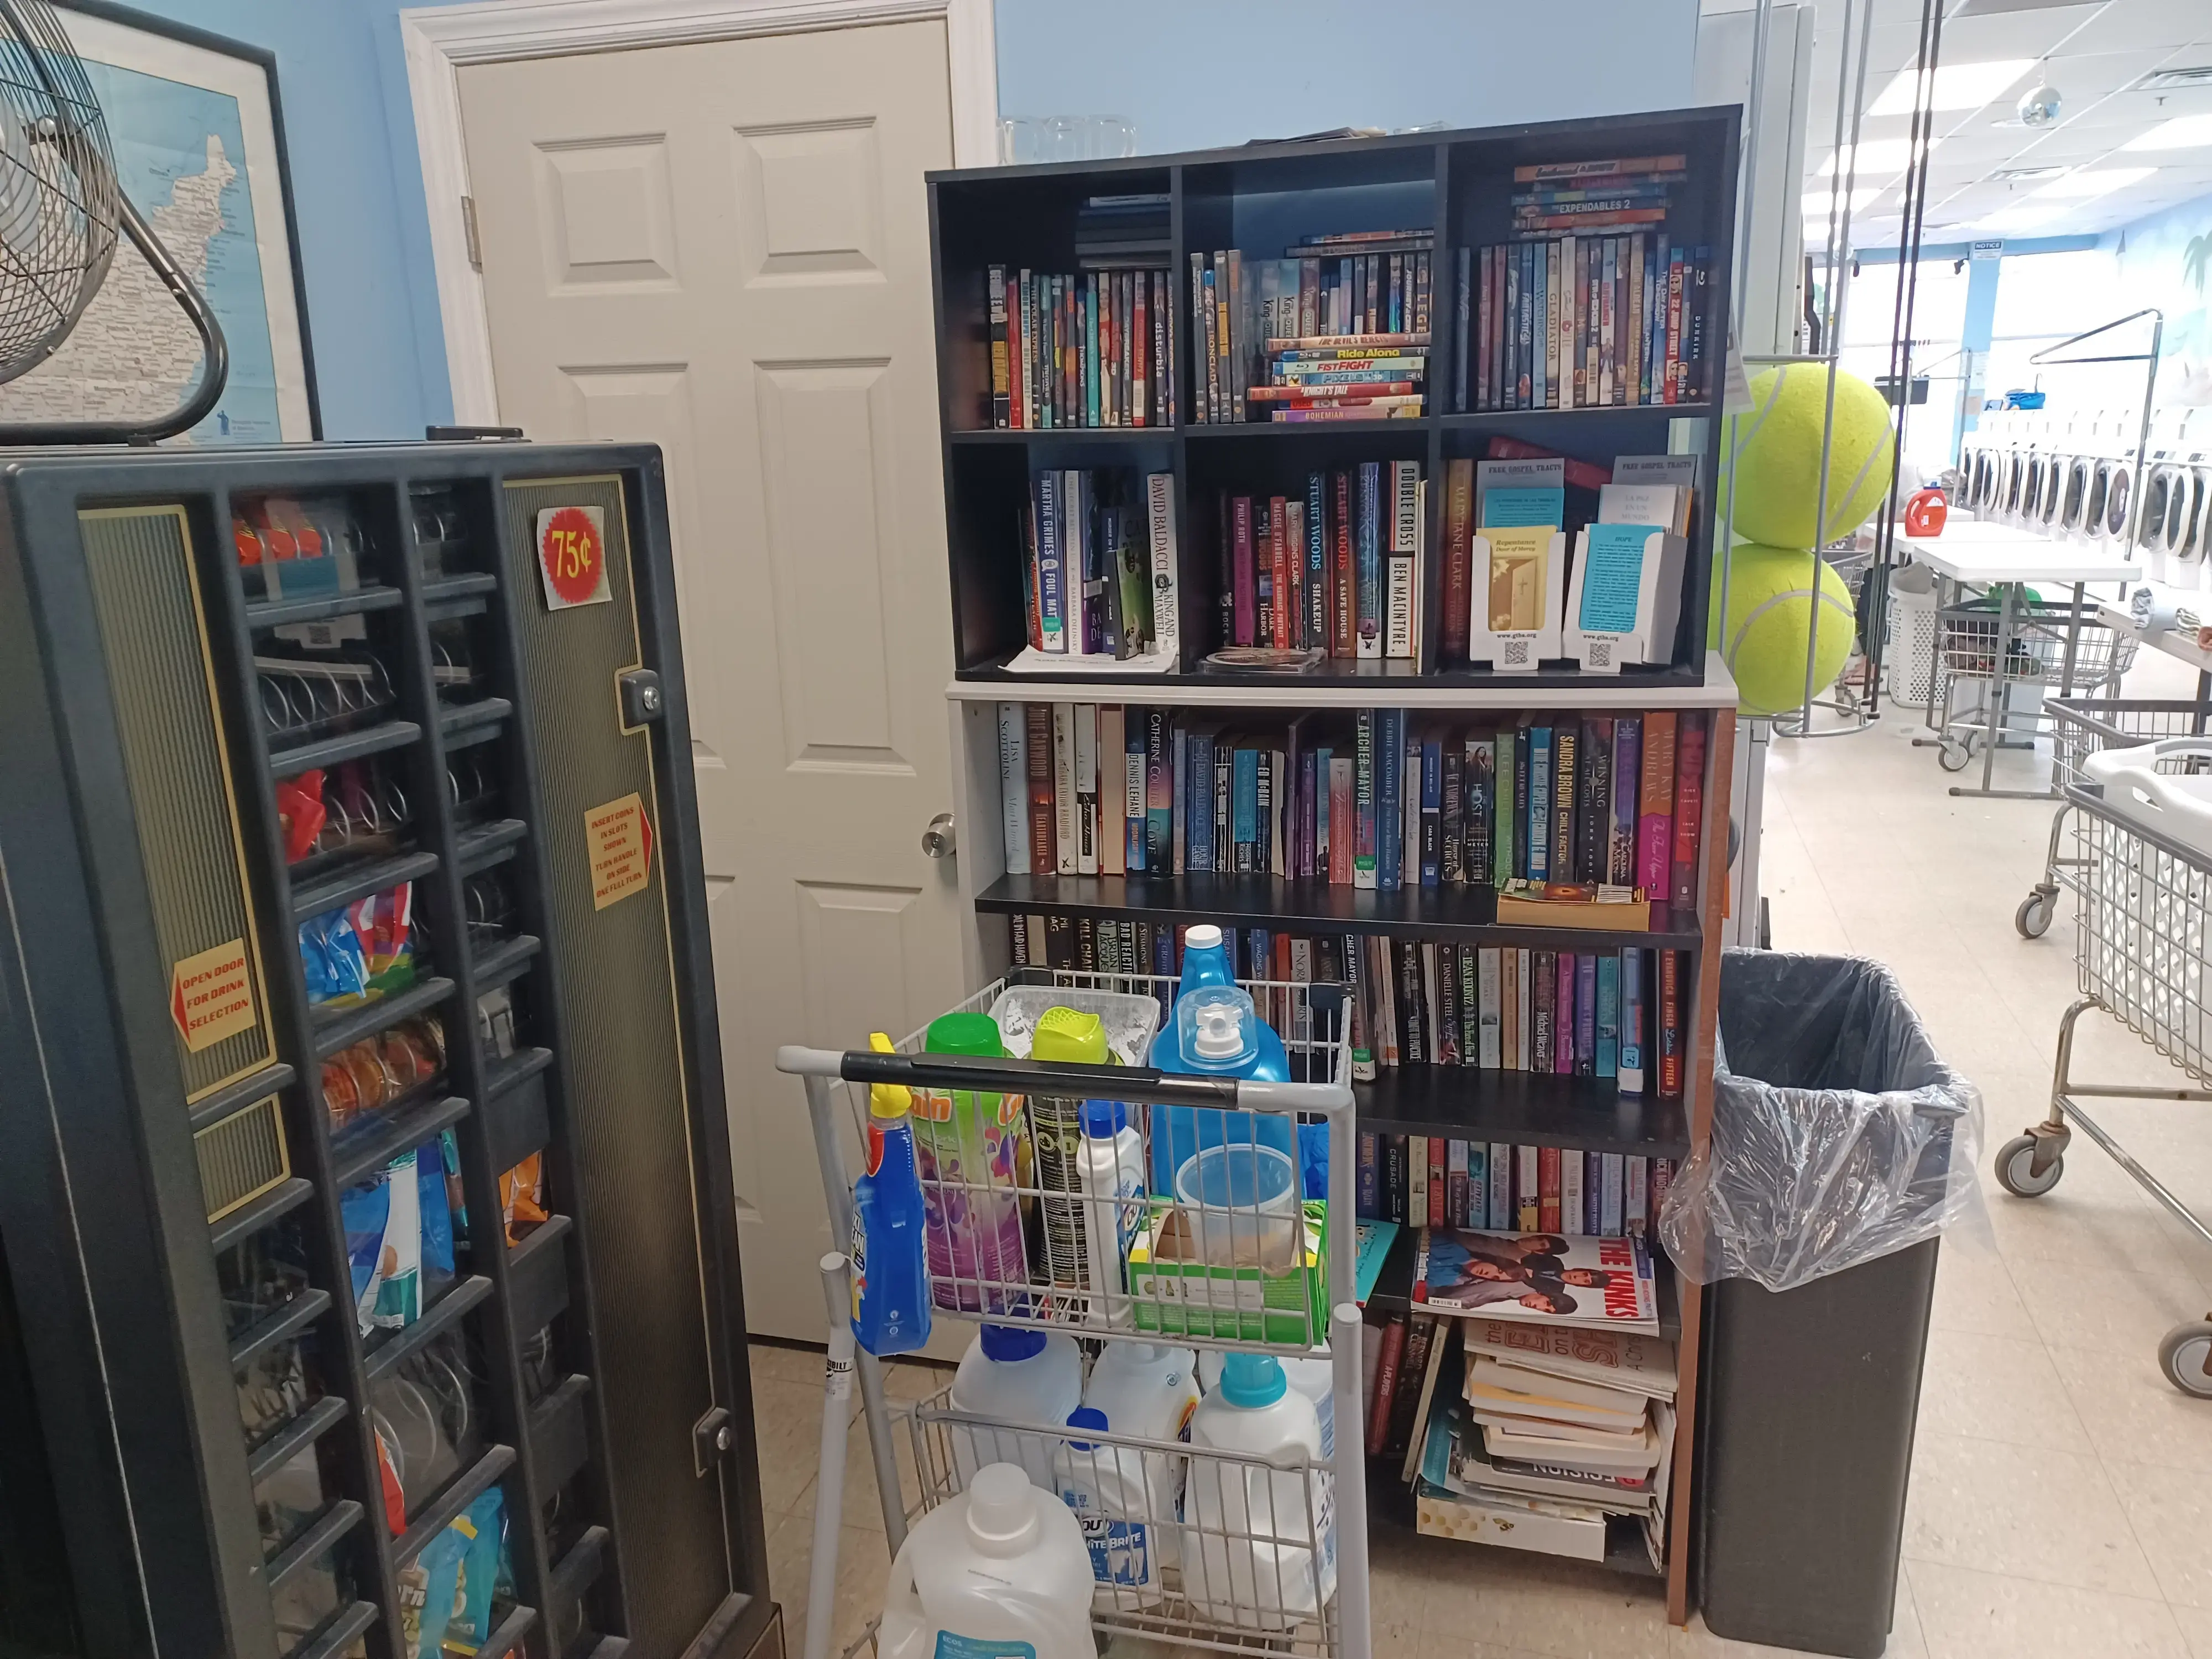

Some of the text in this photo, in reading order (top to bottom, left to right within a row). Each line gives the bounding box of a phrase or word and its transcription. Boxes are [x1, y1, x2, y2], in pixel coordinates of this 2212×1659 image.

[1559, 200, 1630, 213] EXPENDABLES 2
[1333, 337, 1358, 345] DEVIL'S
[1548, 293, 1557, 361] GLADIATOR
[1669, 299, 1679, 356] 22 JUMP STREET
[1111, 362, 1117, 375] 3D
[1208, 330, 1218, 382] IRONCLAD
[1337, 349, 1400, 358] Ride Along
[1338, 361, 1374, 370] FIGHT
[1274, 503, 1282, 529] MAGGIE
[1337, 476, 1348, 522] STUART
[1400, 468, 1415, 545] DOUBLE CROSS
[1152, 478, 1168, 570] DAVID BALDACCI
[1452, 486, 1464, 589] MARY JANE CLARK
[551, 530, 592, 579] 75¢
[1274, 532, 1282, 567] O'FARRELL
[1310, 477, 1321, 633] STUART WOODS SHAKEUP
[1338, 524, 1348, 570] WOODS
[1154, 594, 1164, 637] MAXWELL
[1164, 594, 1175, 637] KING AND
[1392, 564, 1407, 645] BEN MACINTYRE
[1000, 720, 1010, 780] SCOTTOLINE
[1010, 740, 1019, 762] LISA
[1358, 725, 1370, 805] ARCHER MAYOR
[1502, 754, 1510, 776] LEE
[1645, 732, 1658, 802] ANDREWS
[1660, 729, 1674, 802] MARY KAY
[1028, 707, 1048, 855] JULIE GARWOOD HEARTBREAKER
[1129, 755, 1139, 784] DENNIS
[1147, 714, 1161, 854] CATHERINE COULTER COVE
[1258, 767, 1269, 806] ED McBAIN
[1597, 755, 1607, 807] WINNING
[1129, 786, 1139, 817] LEHANE
[1472, 784, 1482, 817] HOST
[1557, 735, 1574, 864] SANDRA BROWN CHILL FACTOR
[592, 807, 634, 828] INSERT COINS
[601, 823, 628, 839] IN SLOTS
[596, 848, 637, 872] TURN HANDLE
[604, 837, 627, 851] SHOWN
[1649, 818, 1665, 879] The Fixer Upper
[597, 872, 642, 898] ONE FULL TURN
[607, 864, 630, 880] ON SIDE
[1108, 937, 1118, 968] BRIAN
[1140, 928, 1148, 963] SUMMONS
[182, 958, 244, 989] OPEN DOOR
[1296, 954, 1306, 982] NORA
[1443, 963, 1452, 997] DANIELLE
[187, 978, 244, 1009] FOR DRINK
[1444, 998, 1453, 1018] STEEL
[190, 998, 248, 1030] SELECTION
[1536, 1012, 1549, 1058] Michael Weaver
[1598, 1238, 1639, 1319] THE KINKS
[1485, 1323, 1501, 1343] the
[1555, 1338, 1568, 1355] on
[1416, 1337, 1428, 1370] BERNARD
[942, 1635, 962, 1647] ECOS
